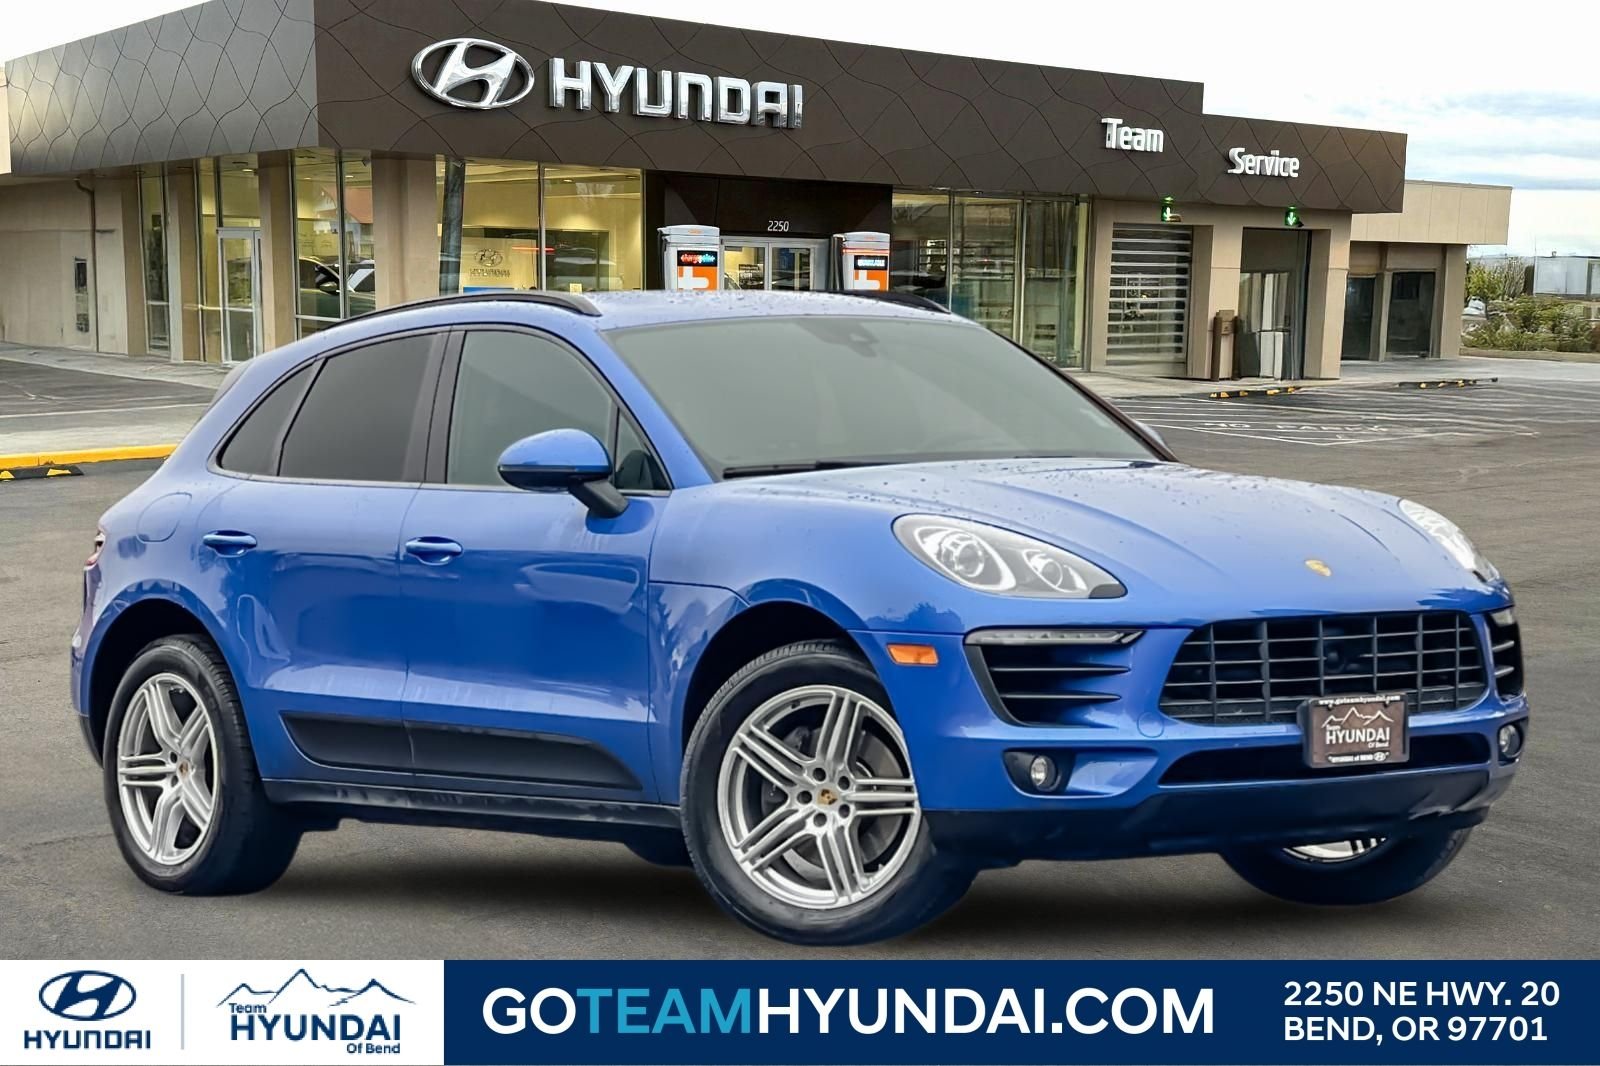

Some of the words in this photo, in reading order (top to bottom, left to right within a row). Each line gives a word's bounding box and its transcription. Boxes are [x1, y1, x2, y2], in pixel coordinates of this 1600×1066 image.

[549, 57, 804, 129] HYUNDAI
[1101, 117, 1164, 153] Team
[1227, 147, 1300, 178] Service
[767, 220, 790, 232] 2250
[1325, 727, 1390, 745] HYUNDAI
